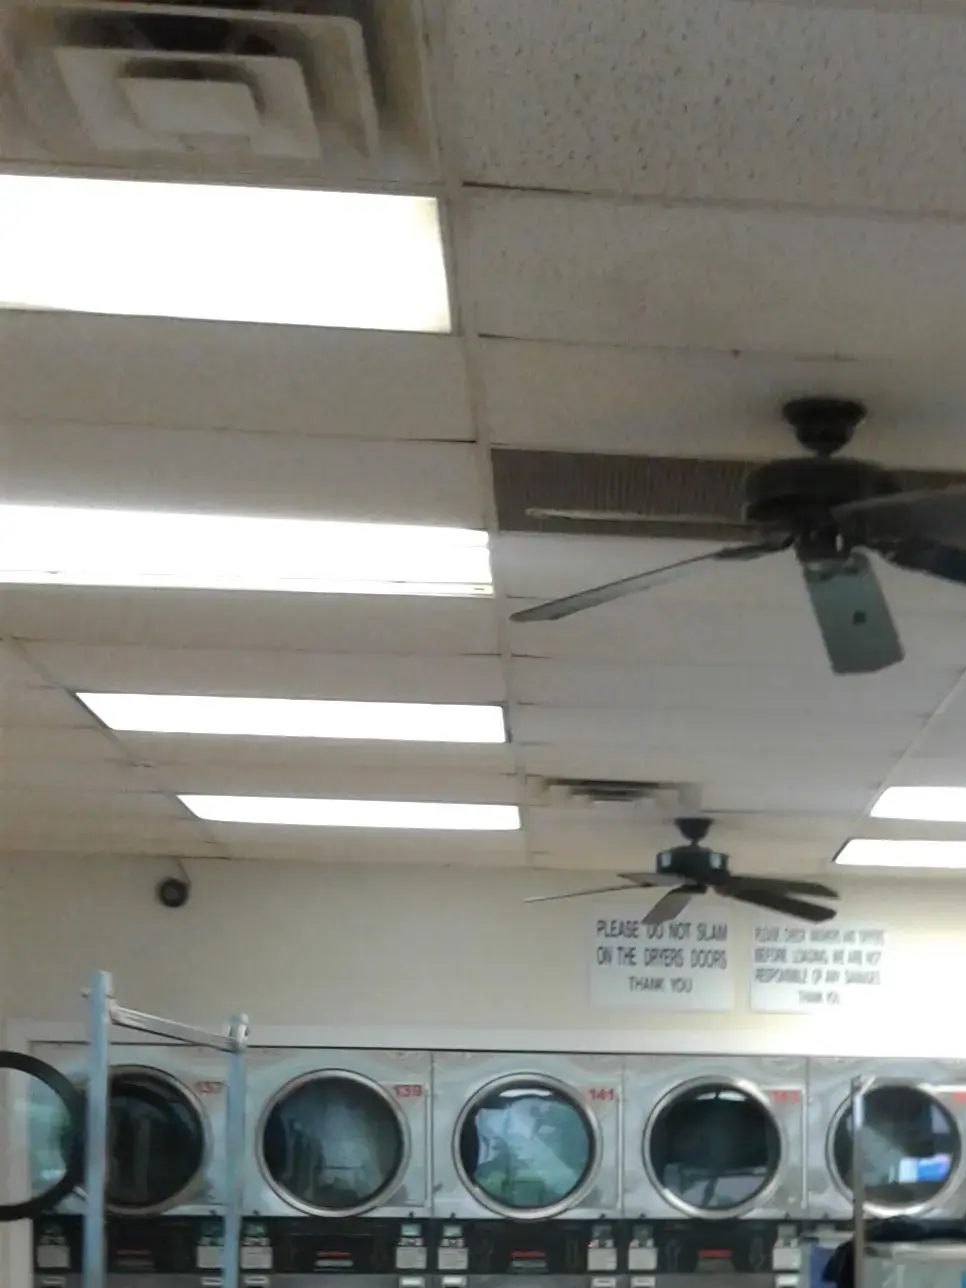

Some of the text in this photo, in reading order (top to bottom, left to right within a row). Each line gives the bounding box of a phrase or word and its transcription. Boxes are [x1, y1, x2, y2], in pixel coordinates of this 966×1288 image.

[597, 920, 728, 940] PLEASE DO NOT SLAM
[597, 946, 727, 969] ON THE DRYERS DOORS
[629, 976, 693, 992] THANK YOU
[588, 1088, 615, 1100] 141
